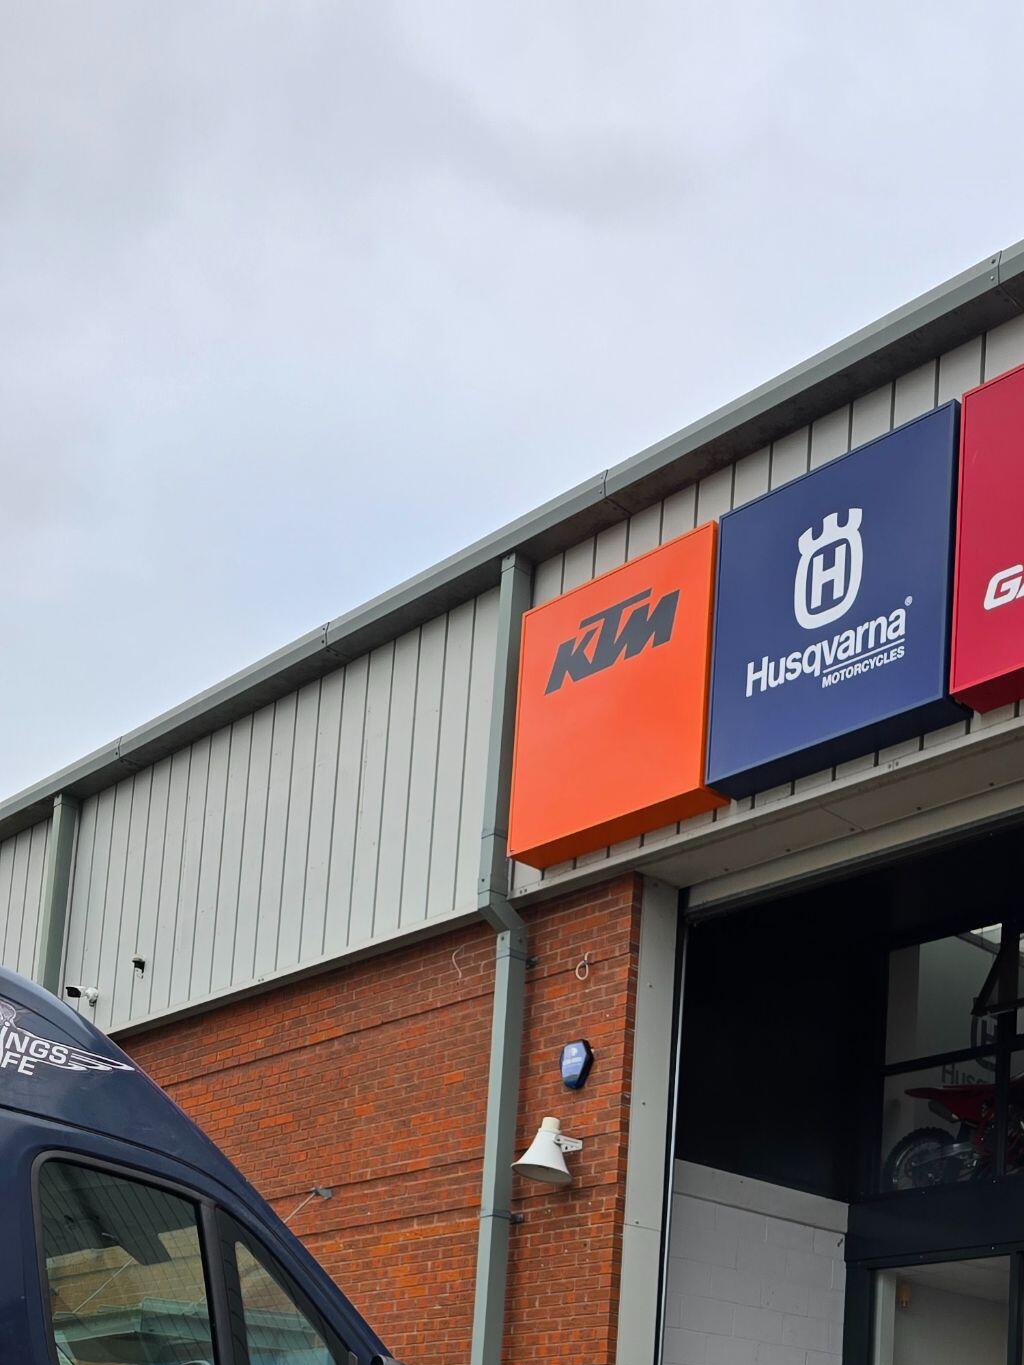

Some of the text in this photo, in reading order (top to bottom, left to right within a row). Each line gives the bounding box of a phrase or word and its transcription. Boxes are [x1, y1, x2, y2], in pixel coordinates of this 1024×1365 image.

[544, 588, 681, 695] KTM
[745, 608, 906, 698] Husqvarna
[821, 645, 905, 689] MOTORCYCLES
